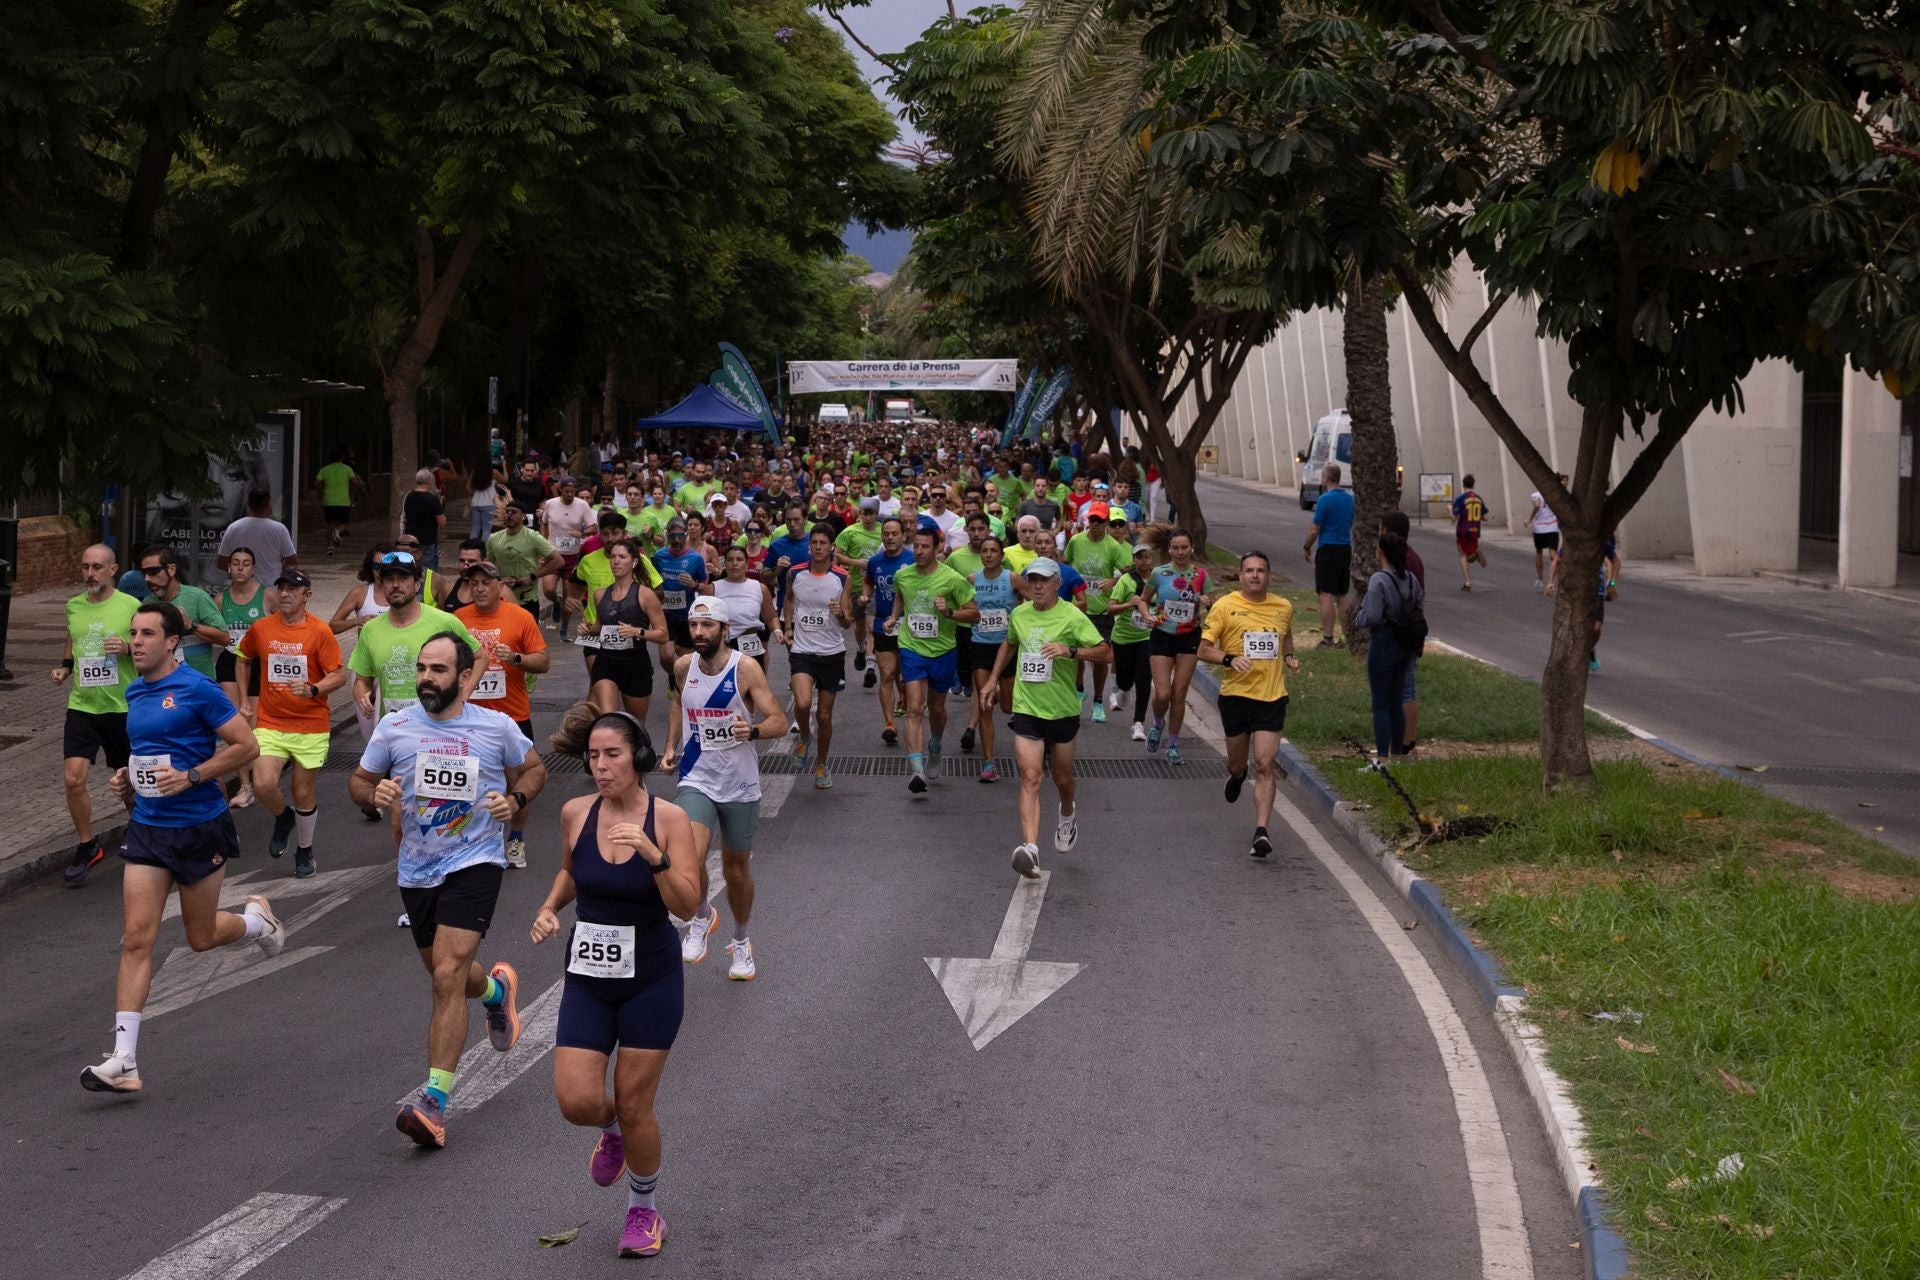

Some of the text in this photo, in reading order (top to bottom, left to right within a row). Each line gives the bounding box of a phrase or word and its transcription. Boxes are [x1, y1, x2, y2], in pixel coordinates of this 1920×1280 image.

[848, 362, 960, 371] Carrera de la Prensa
[1466, 503, 1482, 522] 10
[162, 529, 216, 540] CABELO
[1168, 607, 1189, 617] 701
[801, 616, 824, 624] 459
[981, 617, 1003, 626] 582
[912, 622, 933, 631] 169
[1250, 641, 1274, 650] 599
[84, 667, 111, 677] 605
[274, 664, 301, 674] 650
[1023, 662, 1045, 673] 832
[136, 771, 157, 784] 55
[424, 768, 467, 787] 509
[579, 941, 621, 962] 259
